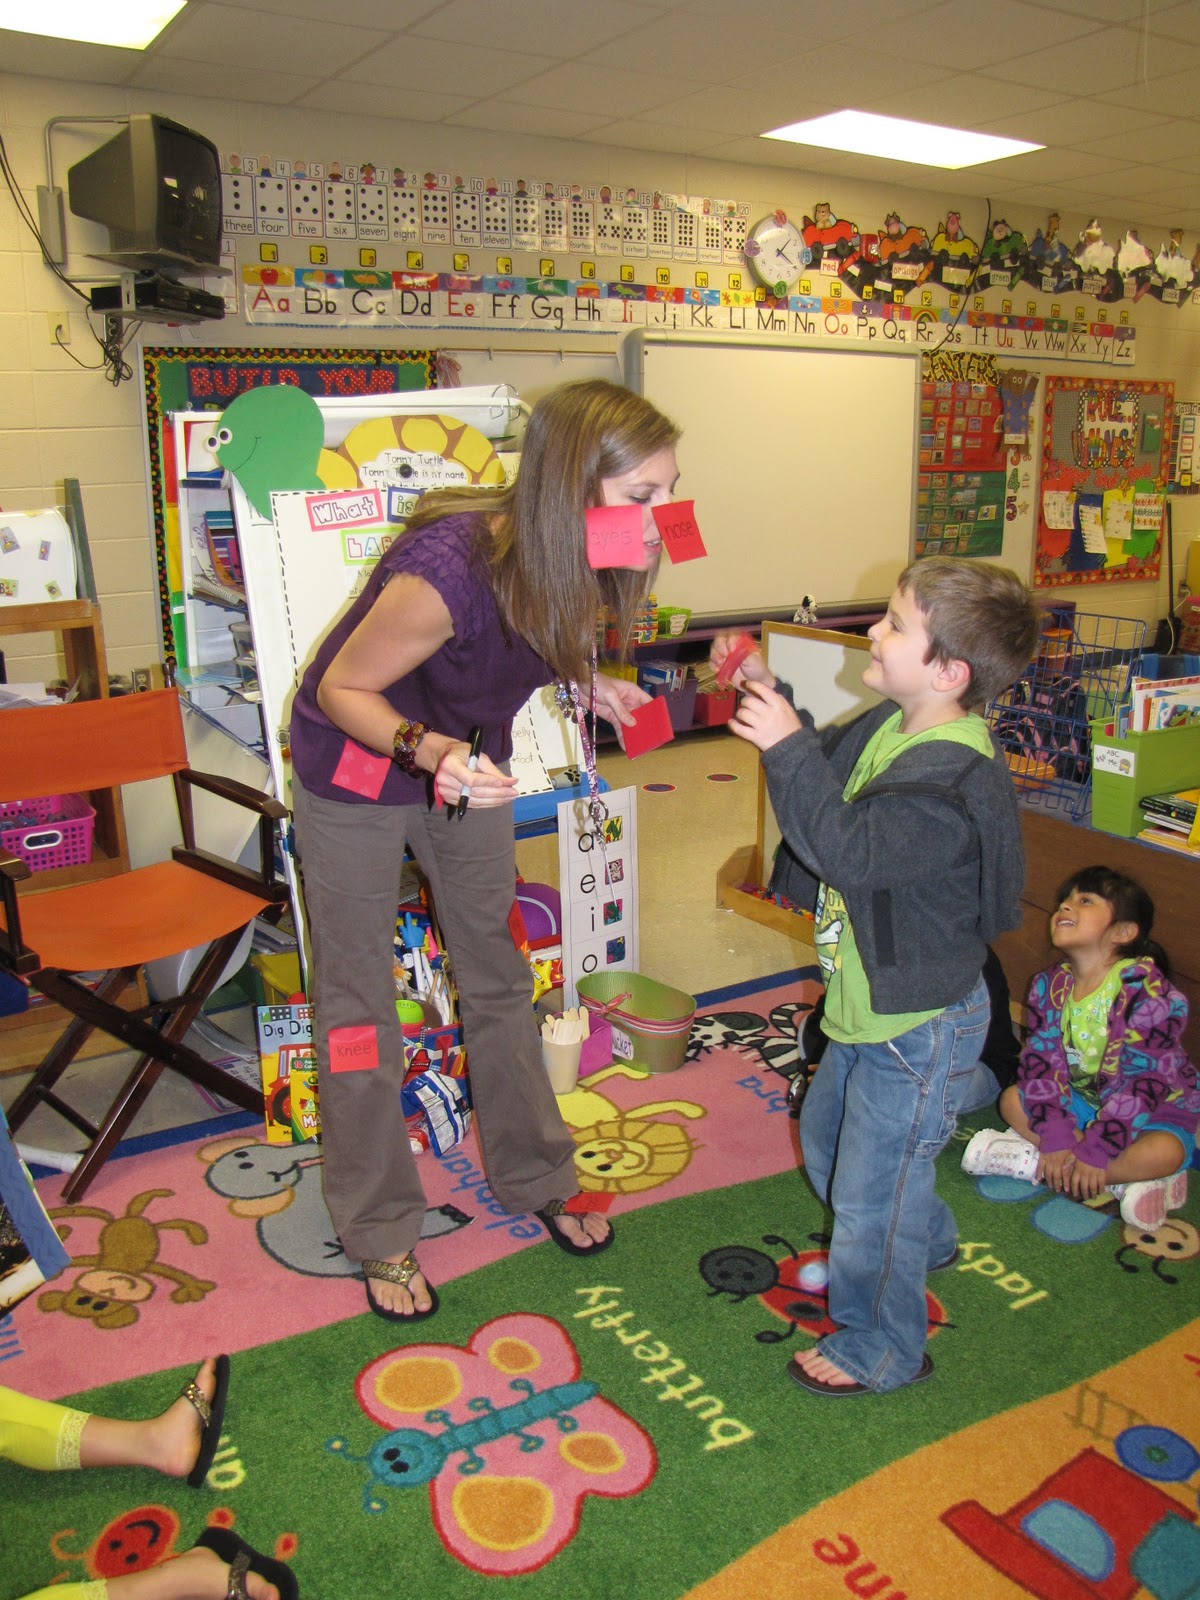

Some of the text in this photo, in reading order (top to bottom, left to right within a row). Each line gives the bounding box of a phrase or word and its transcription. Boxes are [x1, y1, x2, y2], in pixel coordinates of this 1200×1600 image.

[248, 161, 254, 171] 3
[280, 164, 286, 174] 4
[315, 166, 320, 176] 5
[349, 168, 354, 179] 6
[380, 170, 385, 181] 7
[411, 174, 417, 184] 8
[441, 175, 447, 185] 9
[472, 180, 482, 190] 10
[503, 183, 511, 192] 11
[532, 185, 542, 195] 12
[560, 186, 570, 197] 13
[587, 189, 596, 199] 14
[615, 190, 624, 201] 15
[641, 195, 651, 205] 16
[666, 198, 674, 208] 17
[715, 203, 724, 212] 19
[741, 206, 750, 215] 20
[225, 219, 253, 231] three
[261, 220, 284, 233] four
[298, 222, 317, 234] five
[333, 226, 348, 235] six
[360, 228, 386, 236] seven
[393, 230, 417, 242] eight
[427, 232, 445, 241] nine
[460, 235, 474, 244] ten
[484, 233, 510, 245] eleven
[271, 250, 276, 260] 1
[319, 253, 326, 262] 2
[368, 256, 375, 265] 3
[415, 259, 421, 267] 4
[822, 262, 837, 271] red
[588, 269, 594, 277] 8
[627, 271, 633, 279] 9
[893, 266, 919, 278] orange
[660, 274, 669, 282] 10
[991, 273, 1010, 284] green
[1043, 279, 1056, 287] blue
[732, 280, 740, 288] 12
[801, 285, 809, 293] 14
[833, 288, 841, 296] 15
[252, 285, 1131, 362] Aa Bb Cc Dd Ee Ff Gg Hh Ii Jj Kk Ll Mm Nn Oo Pp Qq Rr Ss Tt Uu Vv Ww Xx Yy Zz
[317, 368, 395, 396] YOUR
[417, 454, 444, 465] Turtle
[395, 467, 419, 478] Tle
[422, 470, 429, 478] is
[1007, 467, 1020, 494] 4
[312, 494, 415, 524] What is
[1005, 496, 1018, 521] 5
[663, 520, 695, 542] nose
[590, 529, 633, 552] eyes
[515, 751, 533, 764] foot
[1106, 749, 1120, 758] ABC
[578, 832, 595, 853] a
[580, 873, 596, 894] e
[590, 906, 595, 932] i
[582, 954, 598, 974] o
[263, 1020, 313, 1038] Dig Dig
[336, 1042, 372, 1058] knee
[438, 1145, 543, 1239] elepha
[574, 1285, 756, 1452] butterfly
